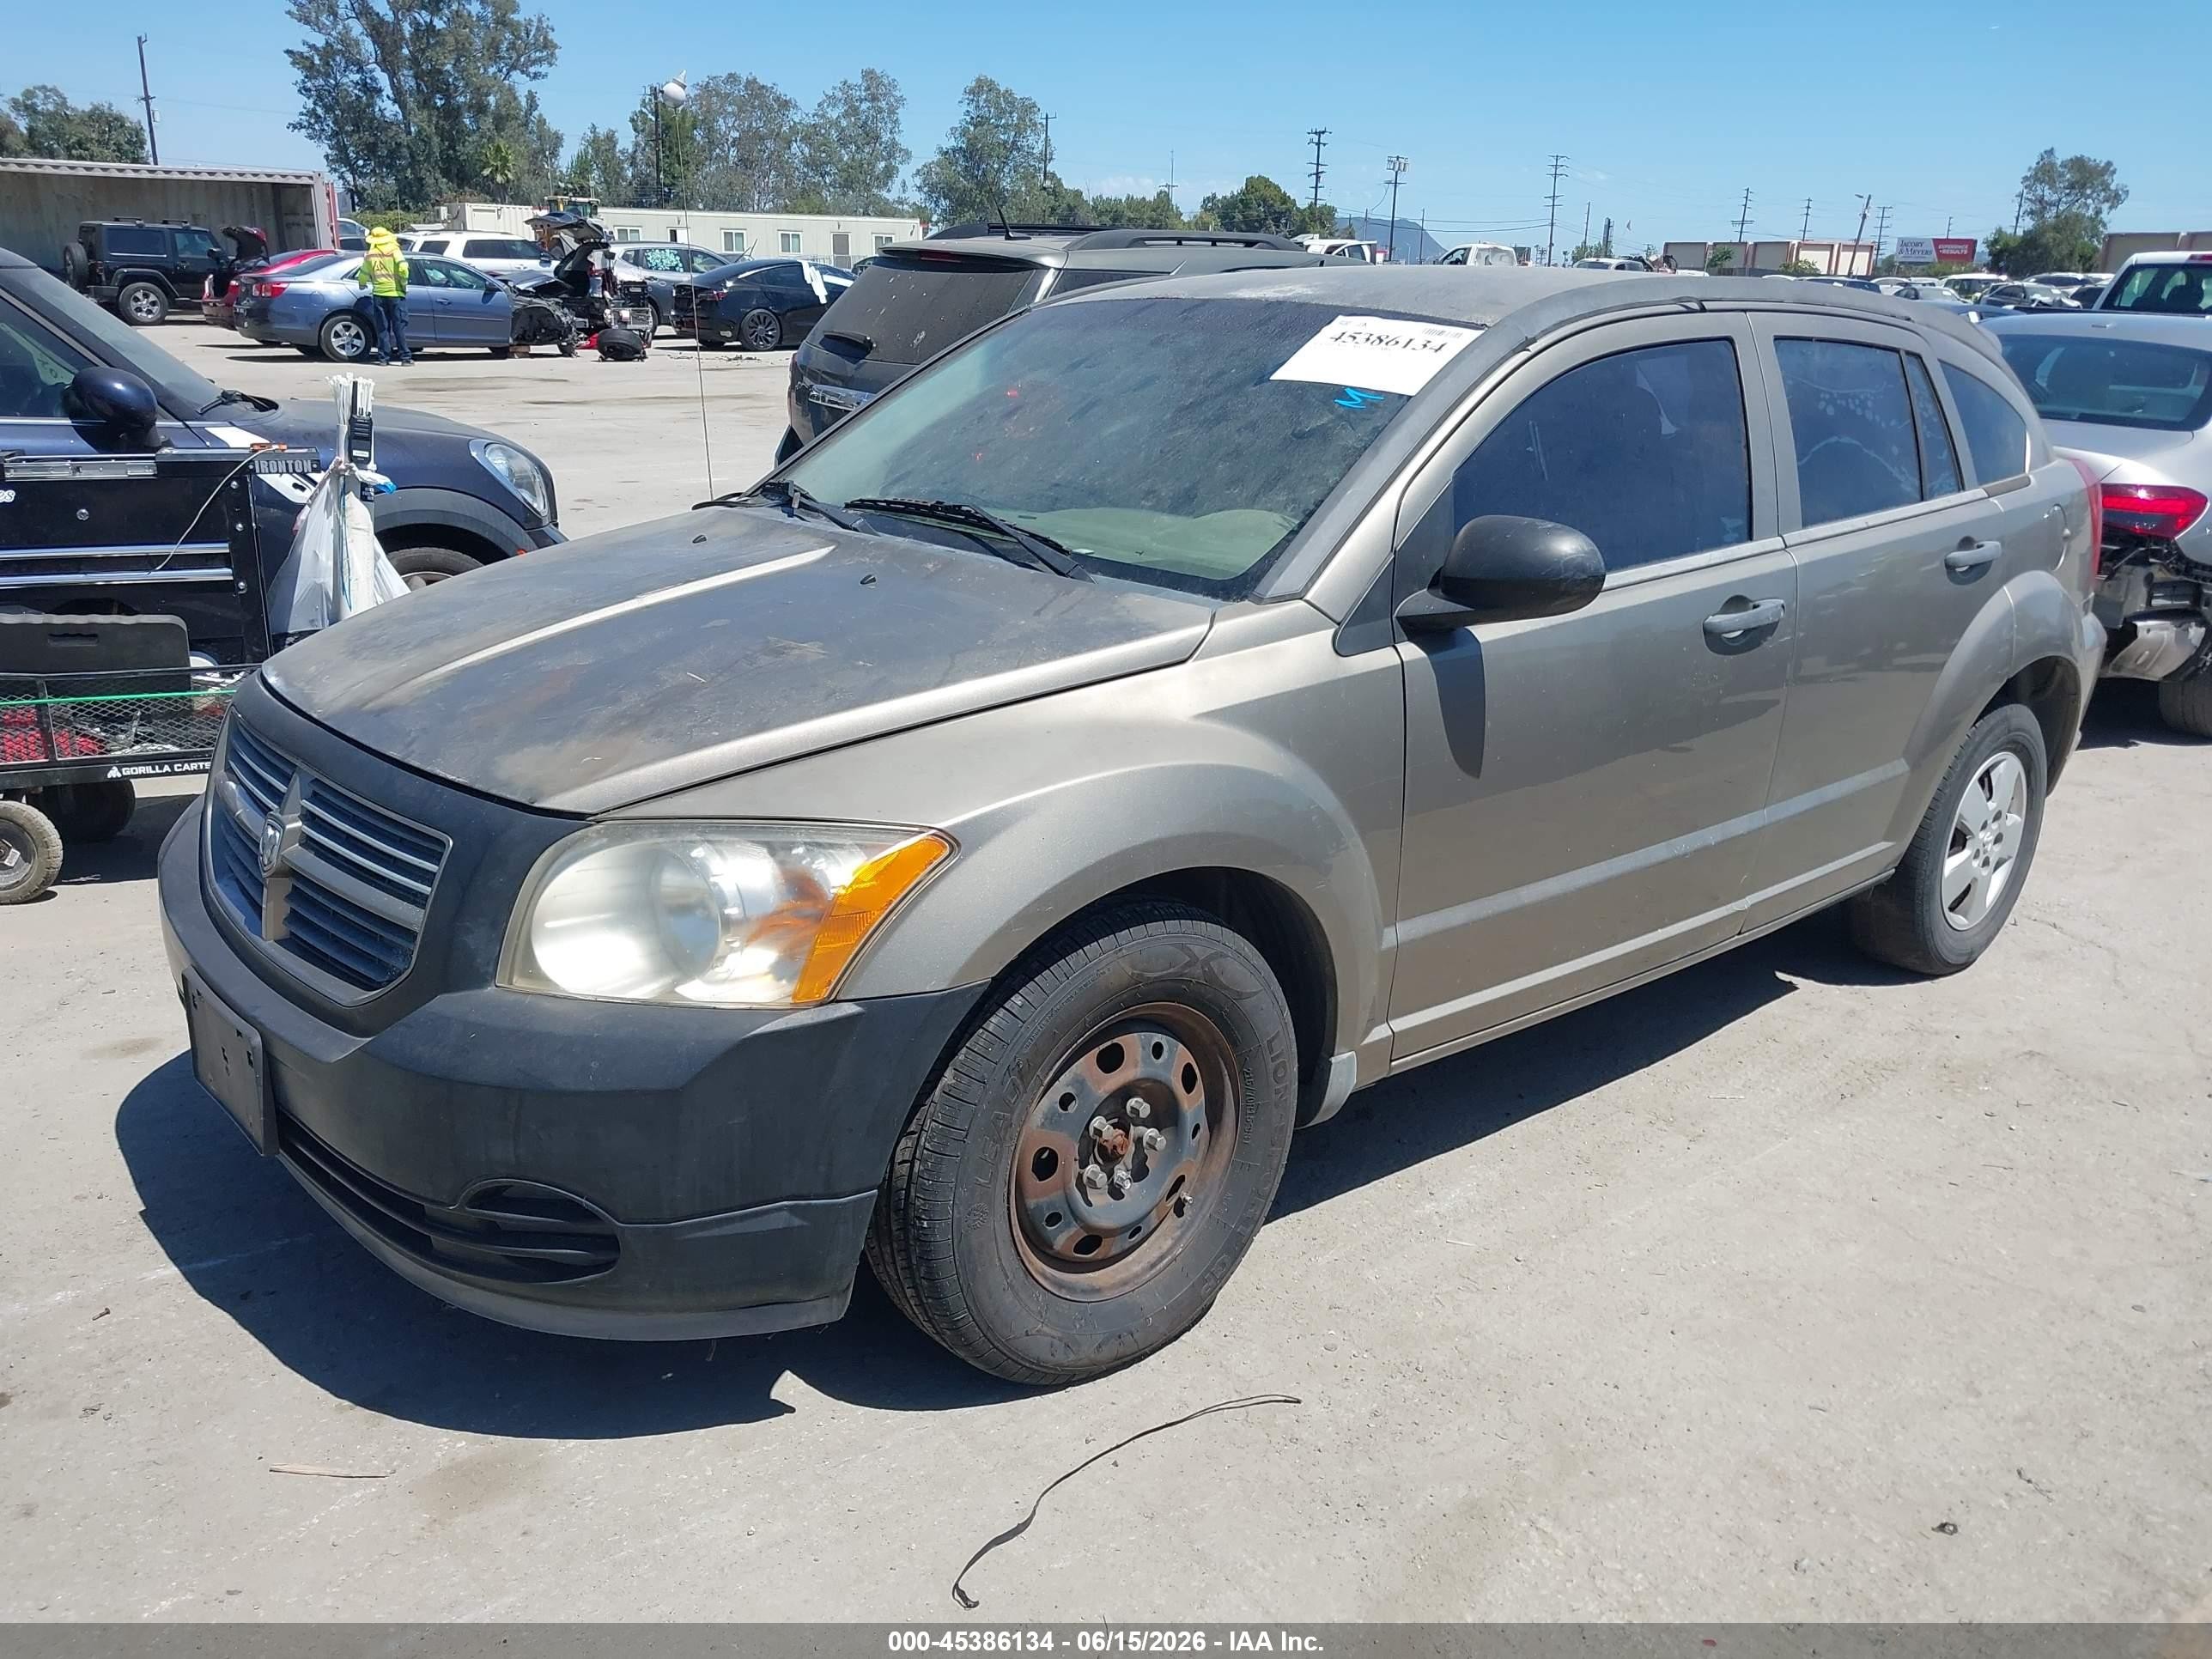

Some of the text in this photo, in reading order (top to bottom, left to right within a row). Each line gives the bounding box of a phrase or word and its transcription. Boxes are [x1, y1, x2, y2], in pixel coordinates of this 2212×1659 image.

[1329, 330, 1448, 354] 45386134
[254, 459, 313, 473] IRONTON
[122, 764, 172, 775] GORILLA
